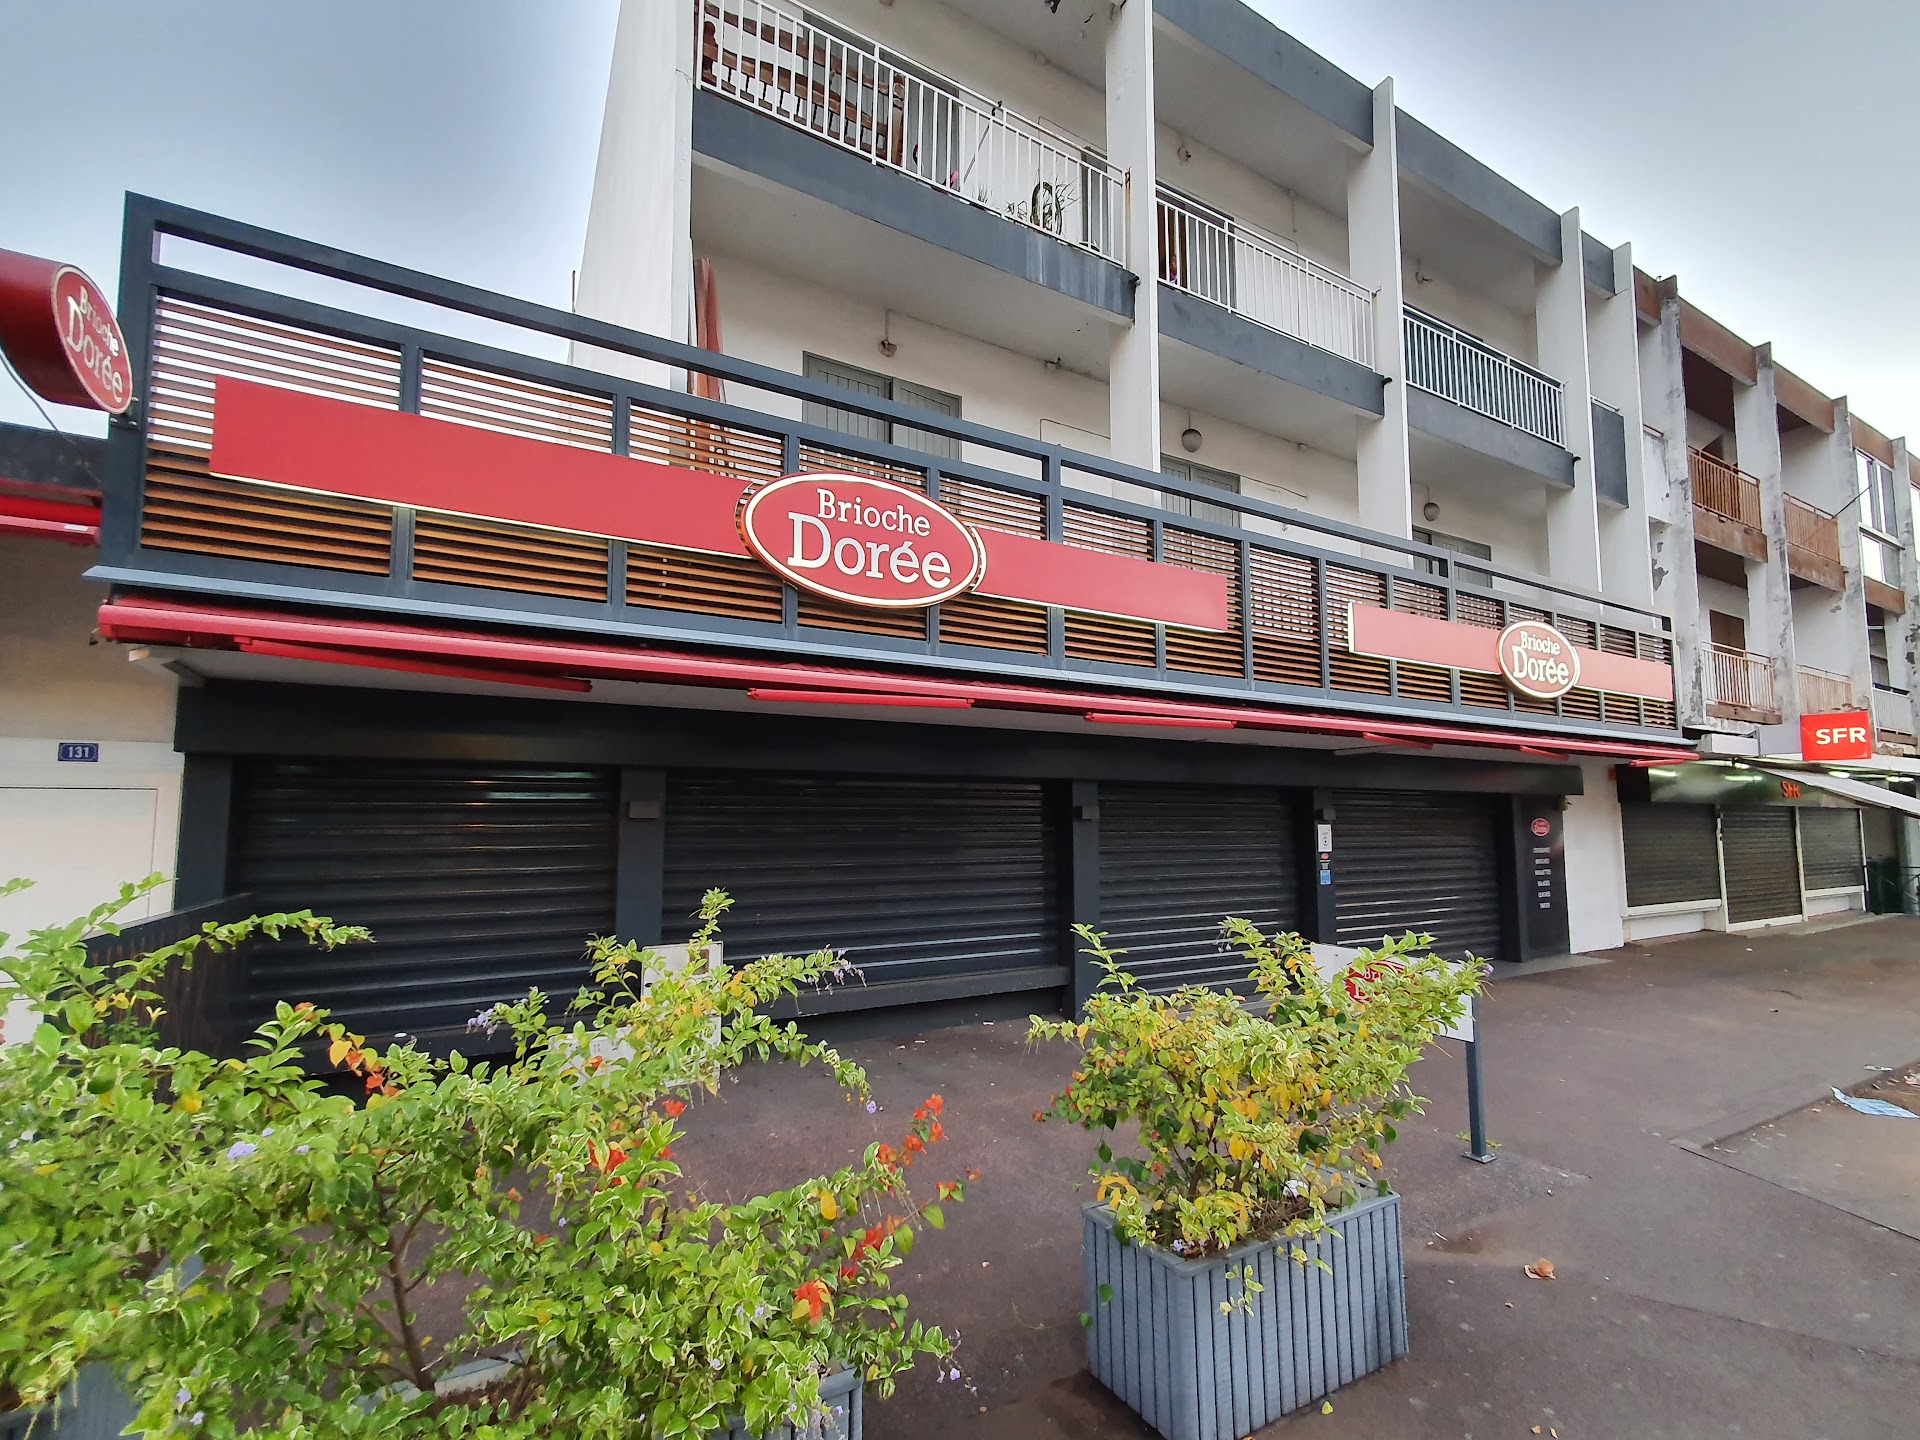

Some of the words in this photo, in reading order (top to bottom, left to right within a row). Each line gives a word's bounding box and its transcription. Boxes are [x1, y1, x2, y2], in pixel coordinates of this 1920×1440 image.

[79, 285, 119, 357] Brioche
[67, 296, 123, 403] Dorée
[816, 488, 931, 537] Brioche
[787, 511, 951, 589] Dorée
[1520, 630, 1561, 655] Brioche
[1511, 645, 1569, 686] Dorée
[68, 746, 89, 758] 131
[1815, 727, 1867, 745] SFR
